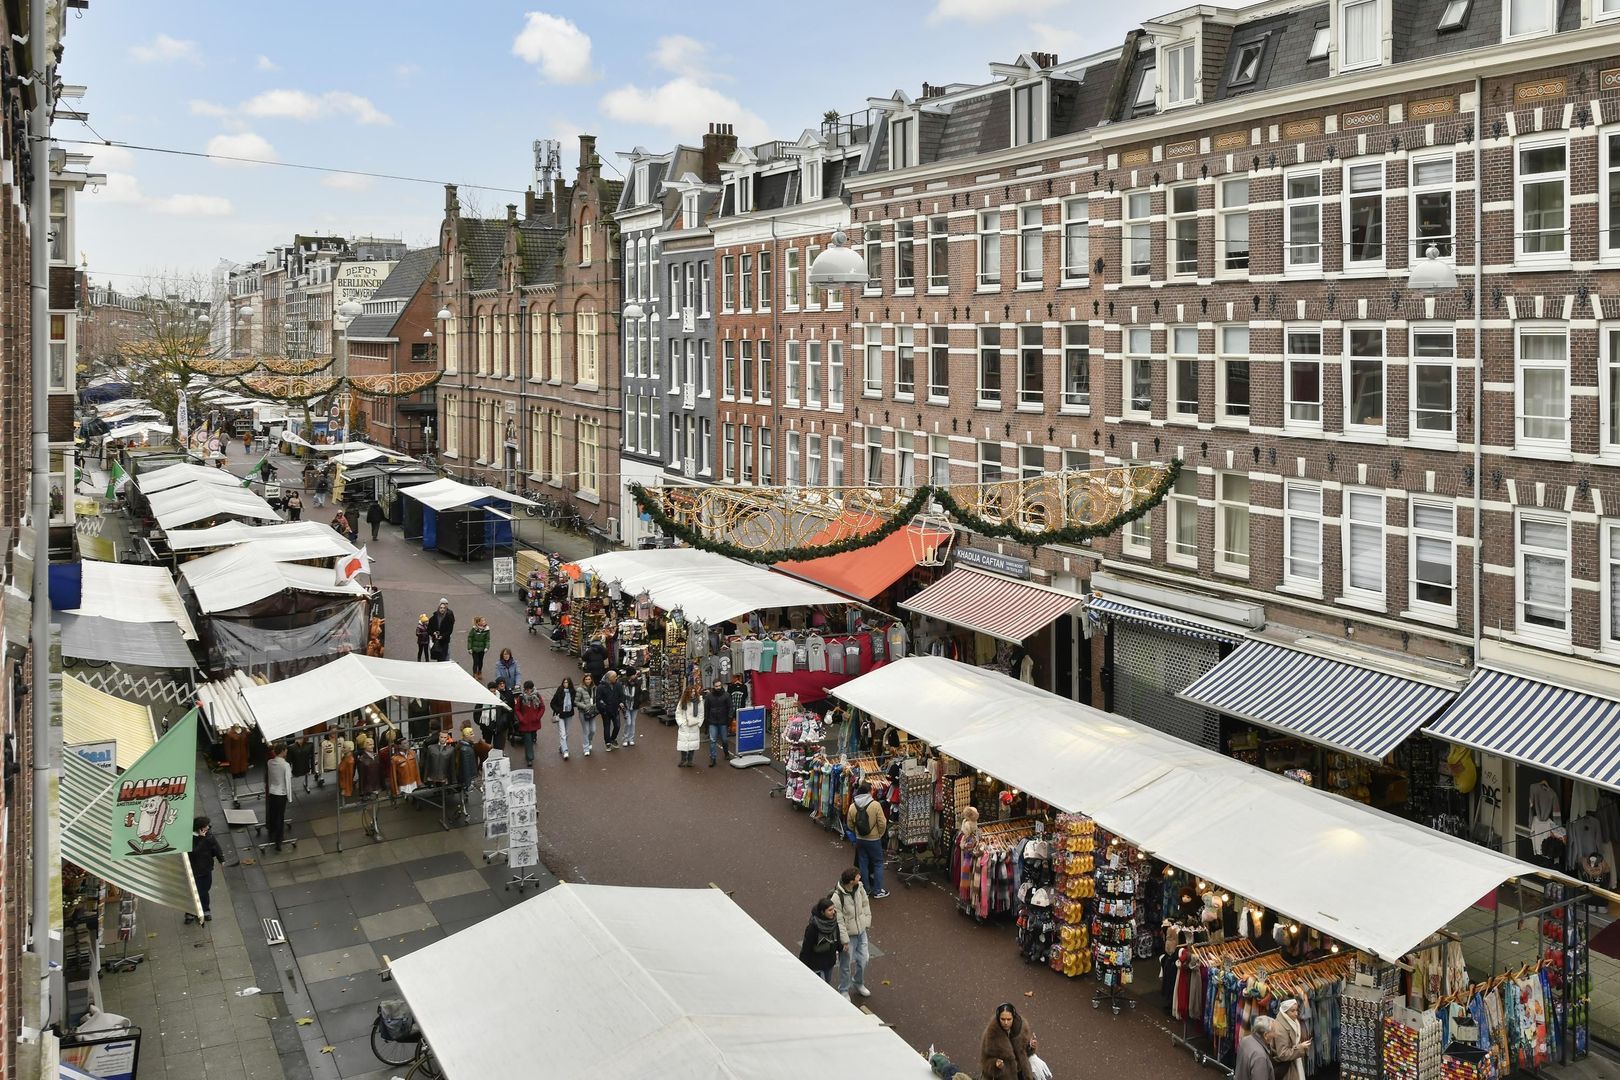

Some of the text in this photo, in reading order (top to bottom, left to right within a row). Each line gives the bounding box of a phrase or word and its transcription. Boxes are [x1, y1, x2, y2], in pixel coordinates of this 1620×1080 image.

[346, 266, 378, 277] DEPOT
[957, 549, 980, 563] KHADIJA
[982, 555, 1005, 569] CAFTAN
[117, 774, 188, 802] RANCHI
